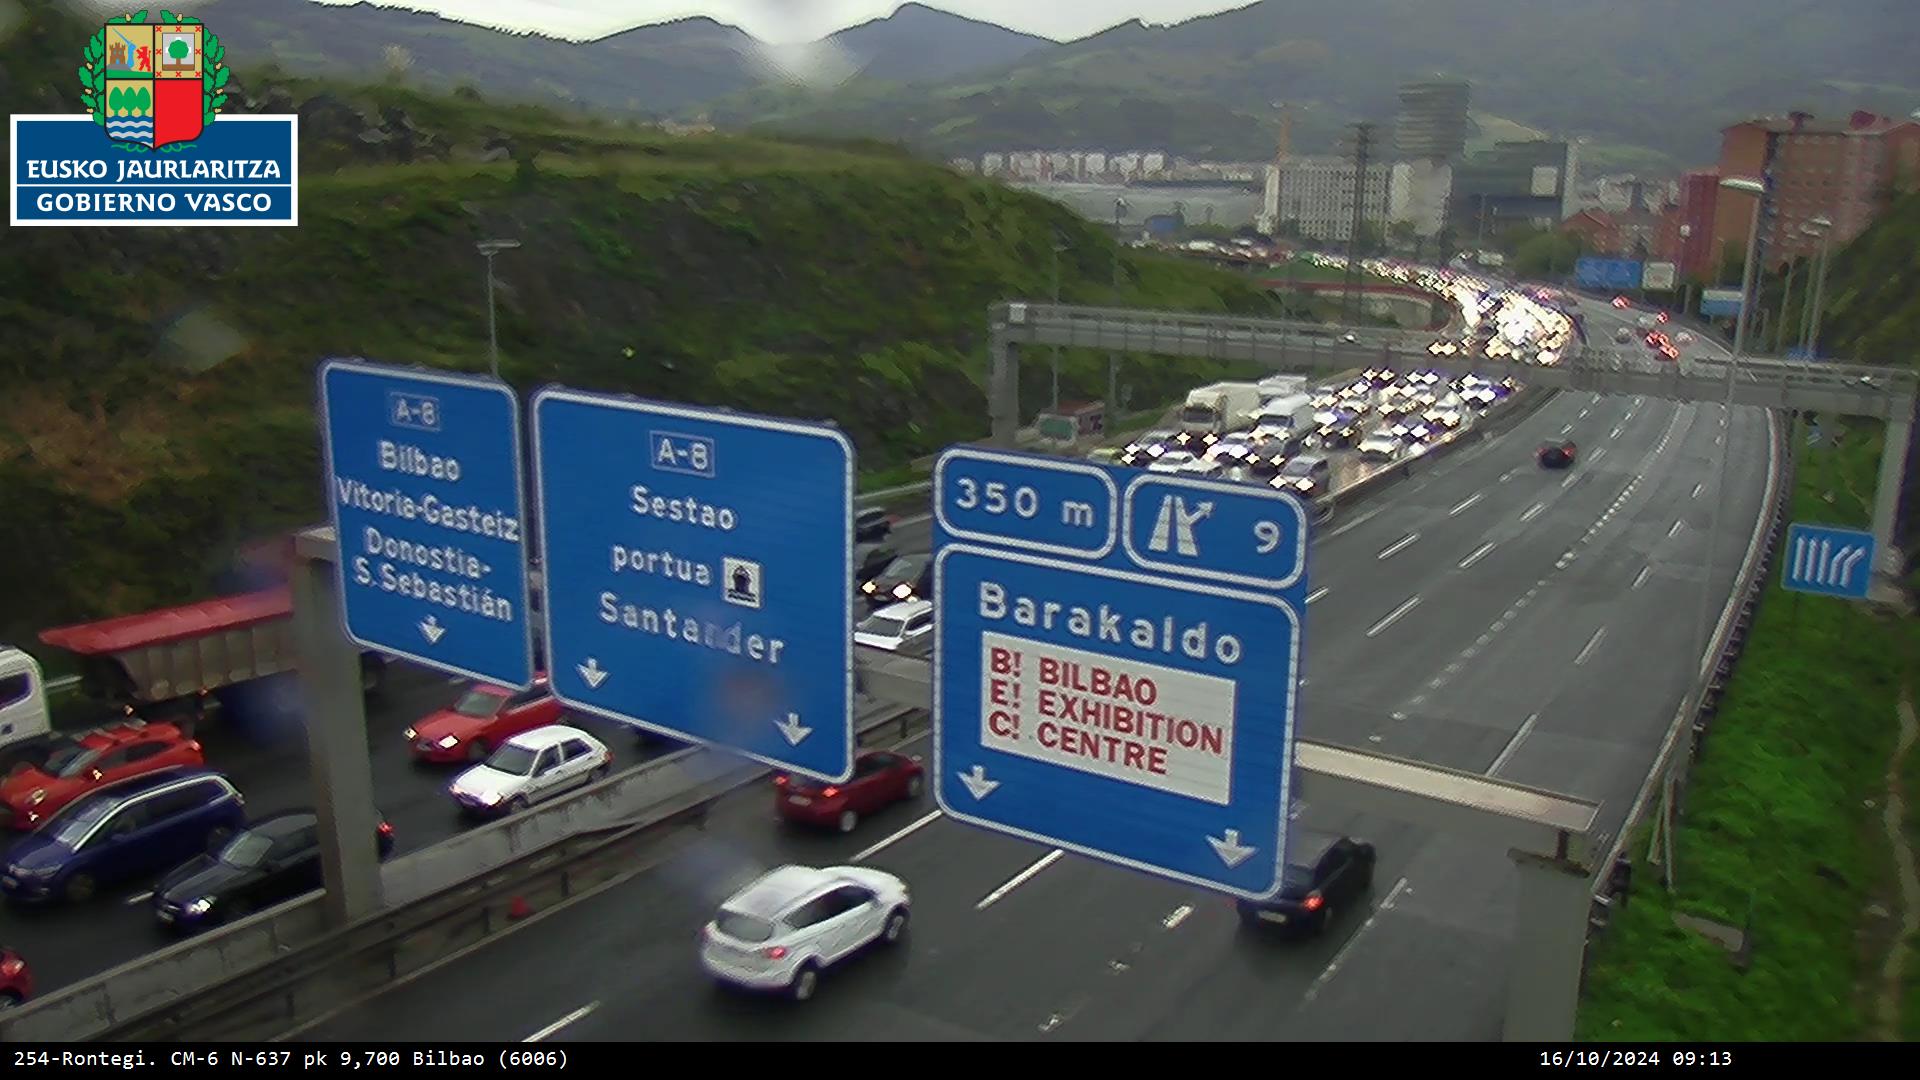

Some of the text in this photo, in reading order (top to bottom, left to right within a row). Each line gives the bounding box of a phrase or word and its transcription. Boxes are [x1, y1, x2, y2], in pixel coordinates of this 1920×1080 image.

[396, 399, 436, 425] A-8
[379, 441, 462, 481] Bilbao
[657, 438, 709, 470] A-8
[336, 476, 520, 541] Vitoria-Gasteiz
[631, 486, 736, 530] Sestao
[956, 478, 1094, 528] 350 m
[365, 527, 491, 579] Donostia-
[1253, 521, 1280, 553] 9
[612, 544, 711, 586] portua
[600, 592, 785, 663] Santander
[979, 581, 1241, 664] Barakaldo
[990, 648, 1157, 705] B! BILBAO
[990, 680, 1223, 754] E! EXHIBITION
[988, 711, 1168, 775] C! CENTRE
